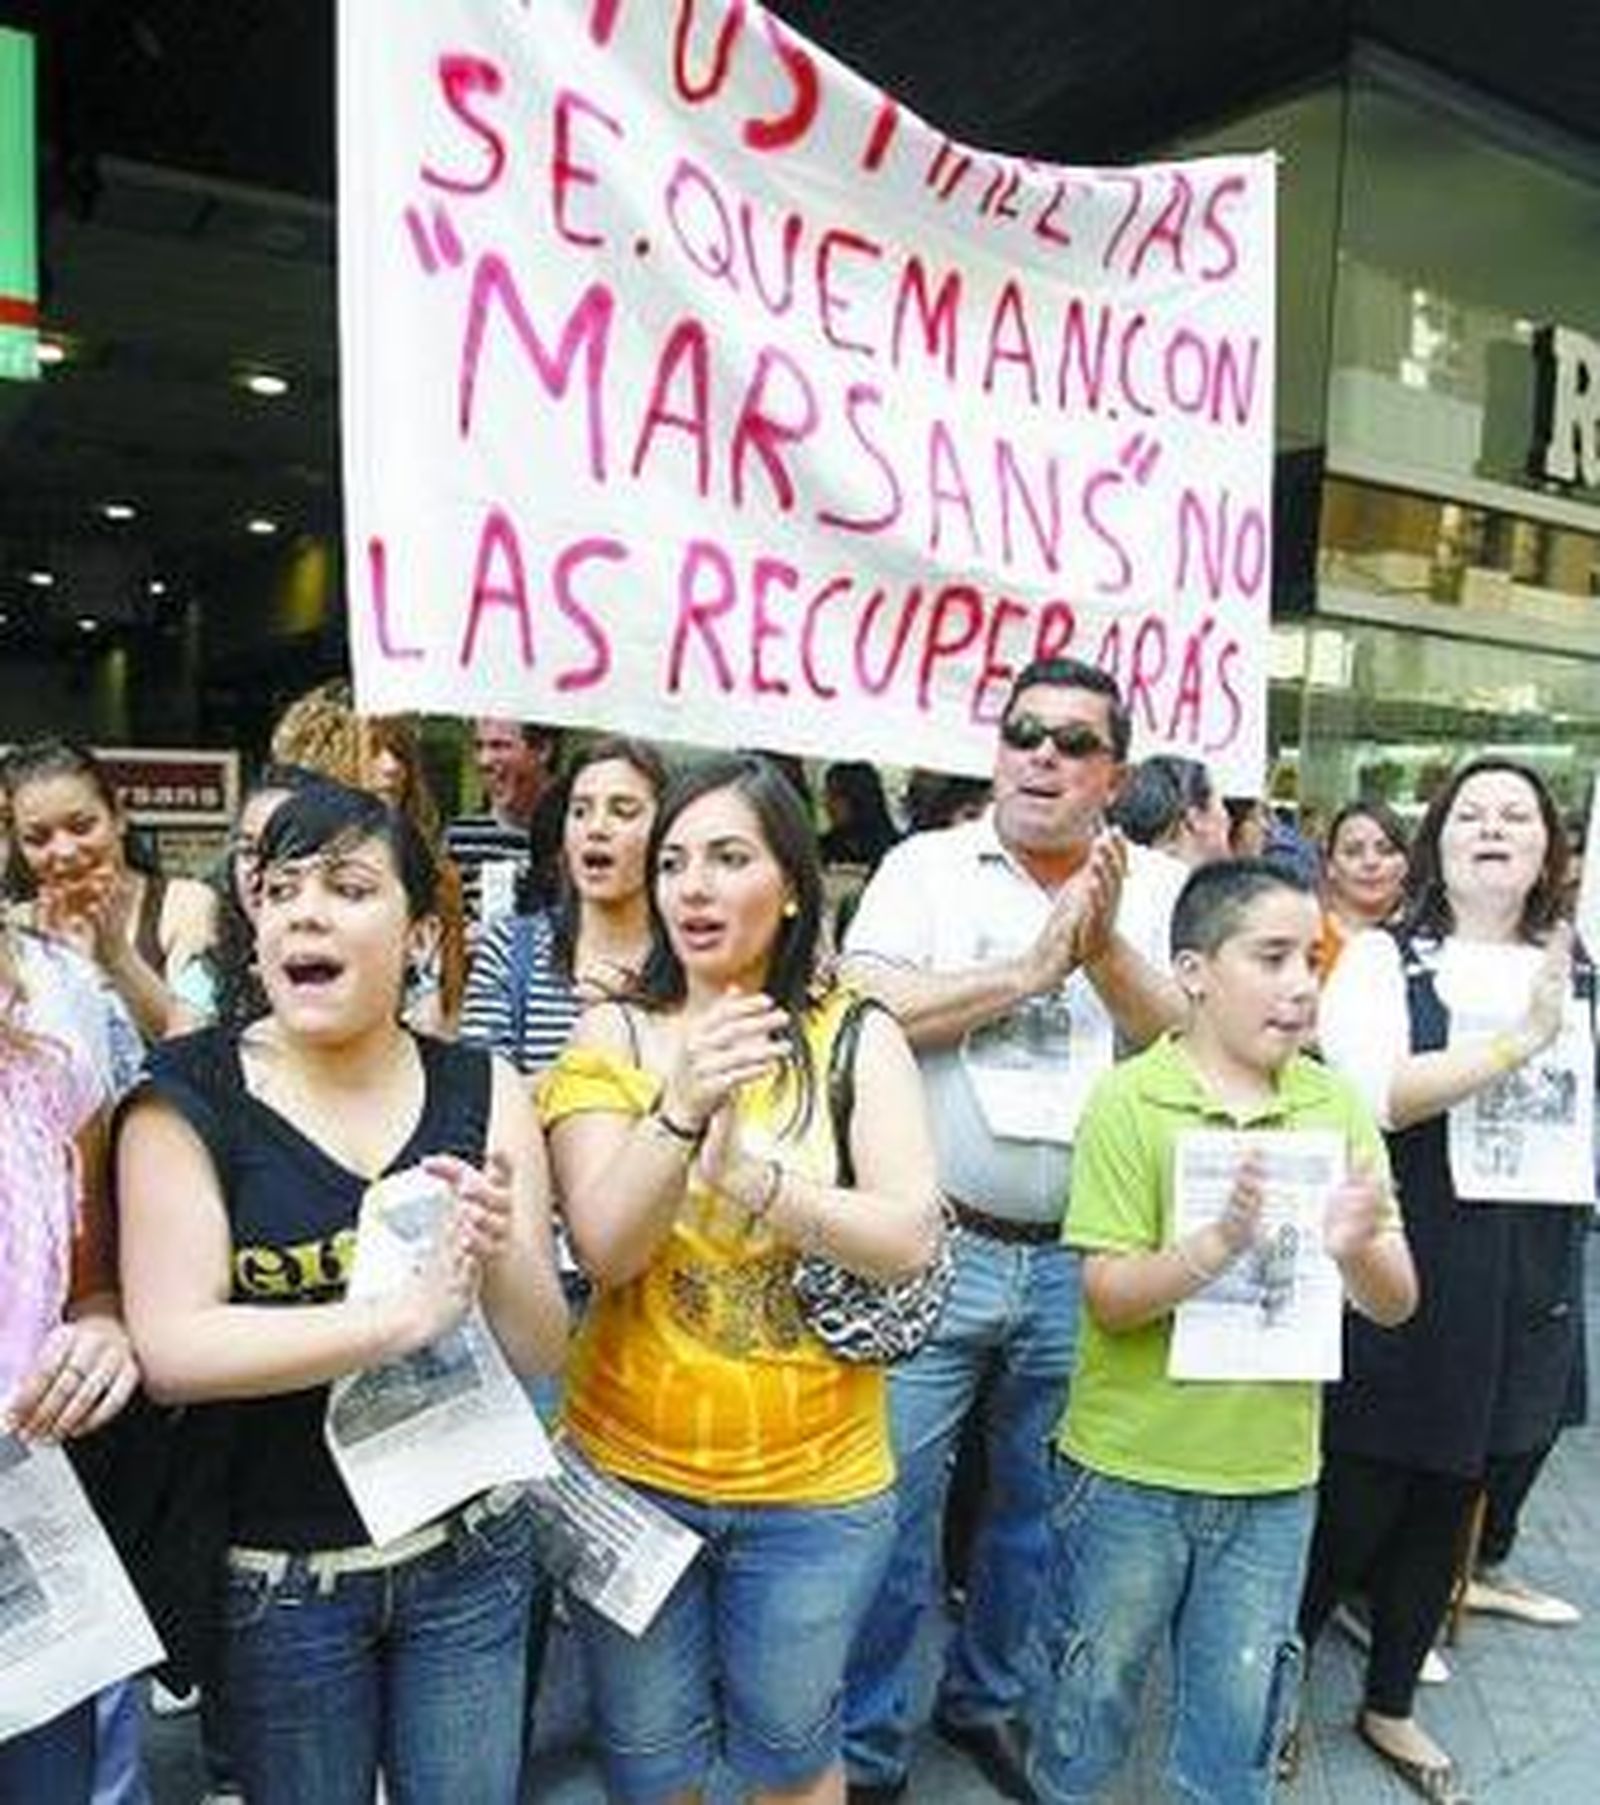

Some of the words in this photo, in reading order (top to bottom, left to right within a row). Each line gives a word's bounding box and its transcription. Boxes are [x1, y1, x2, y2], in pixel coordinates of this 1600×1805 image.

[590, 0, 819, 151] US
[1118, 313, 1259, 425] CON
[368, 502, 627, 692] LAS
[1176, 488, 1266, 600] NO
